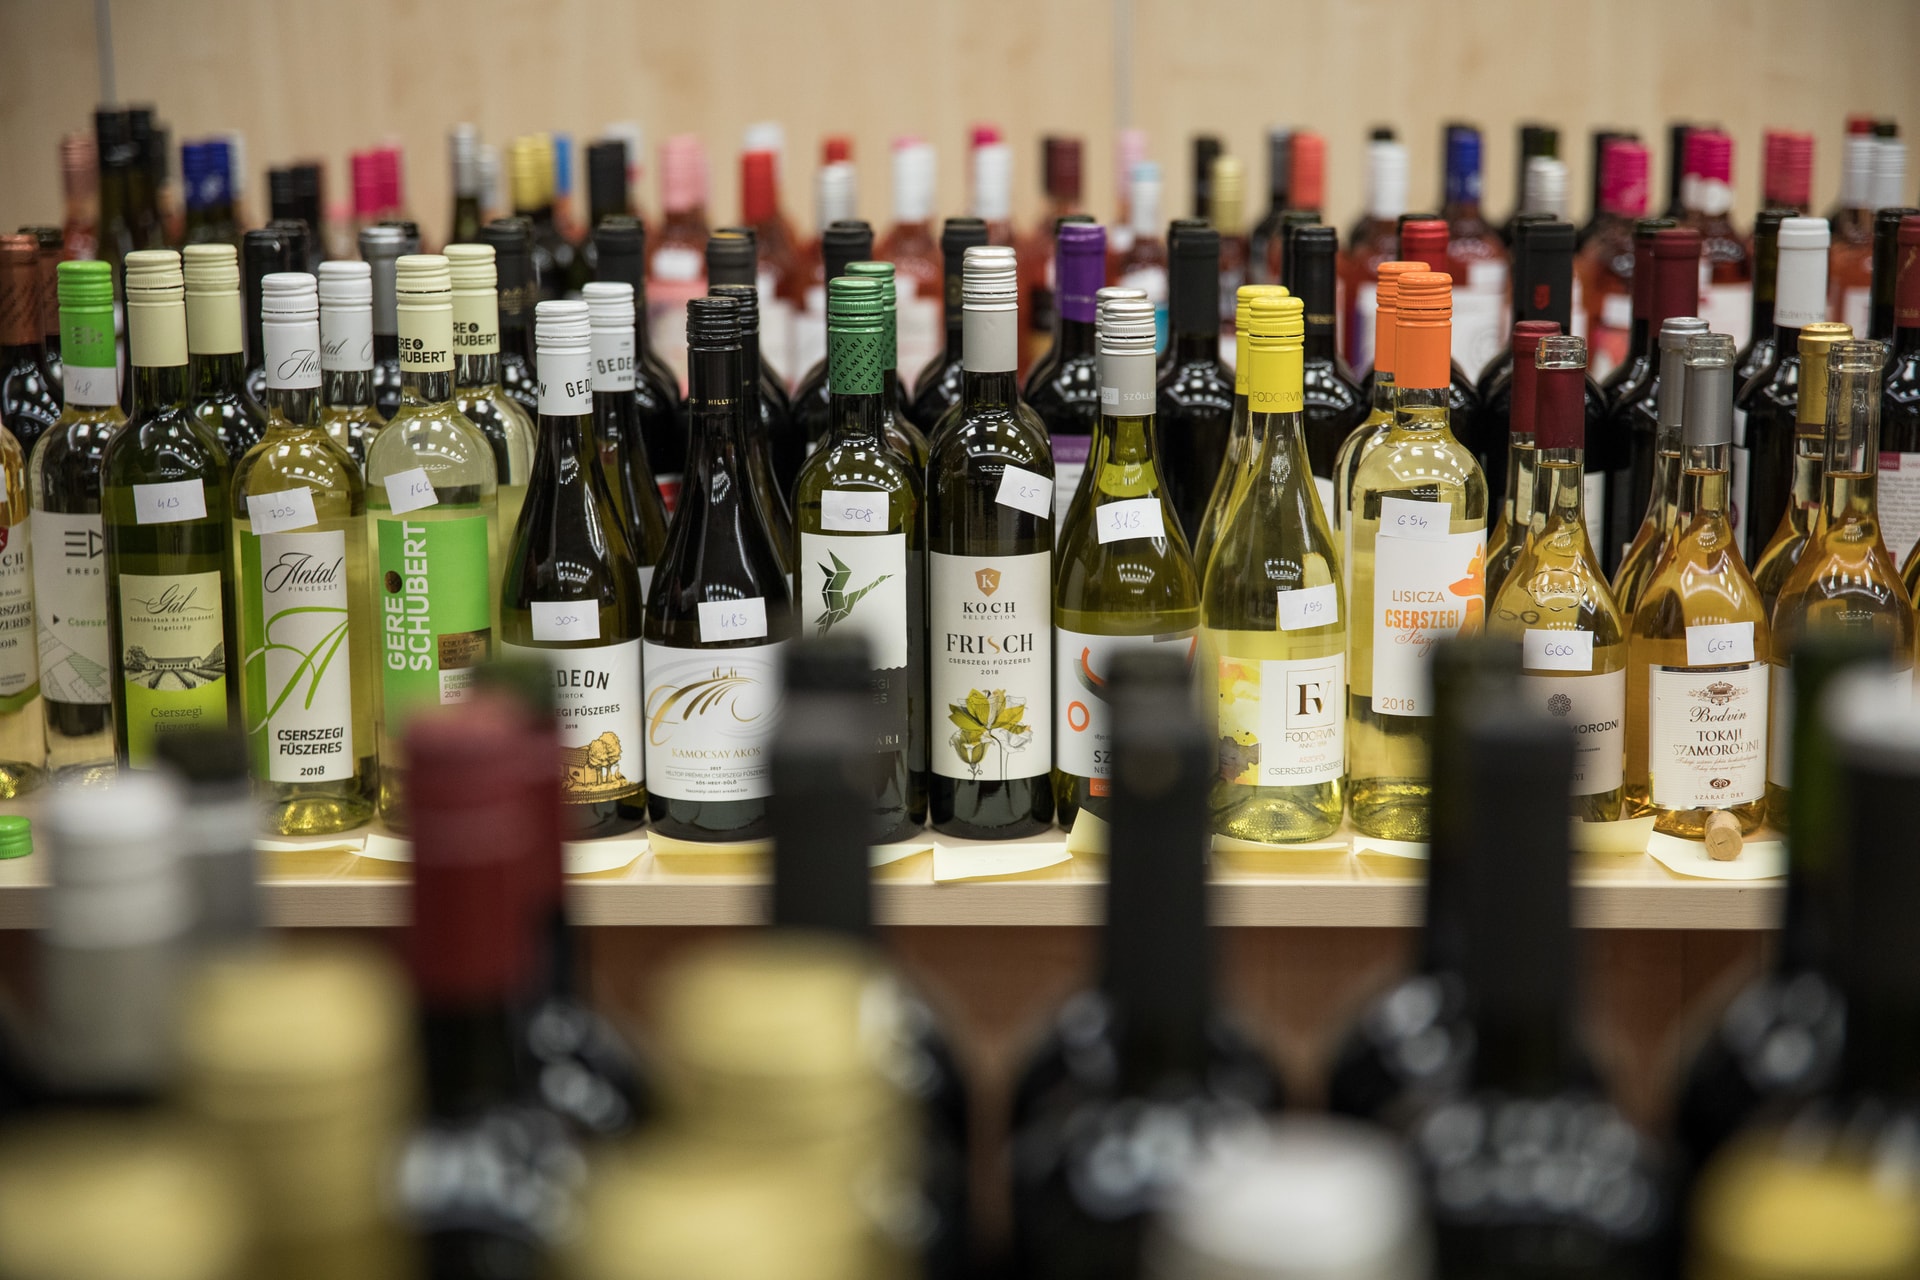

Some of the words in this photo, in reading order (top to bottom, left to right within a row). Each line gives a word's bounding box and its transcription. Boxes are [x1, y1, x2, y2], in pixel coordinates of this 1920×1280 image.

[1019, 486, 1041, 498] 25
[842, 508, 874, 523] 508
[263, 551, 344, 594] Antal
[403, 520, 432, 671] SCHUBERT
[1392, 589, 1445, 604] LISICZA
[962, 601, 1016, 614] KOCH
[1384, 608, 1460, 629] CSERSZEGI
[385, 596, 407, 671] GERE
[946, 632, 1034, 655] FRISCH
[1707, 638, 1734, 654] 667
[553, 669, 610, 691] DEON
[150, 704, 203, 719] Cserszegi
[1381, 697, 1416, 712] 2018
[1689, 705, 1748, 724] Bodvin
[276, 726, 344, 742] CSERSZEGI
[1695, 727, 1743, 743] TOKAJI
[299, 765, 326, 777] 2018
